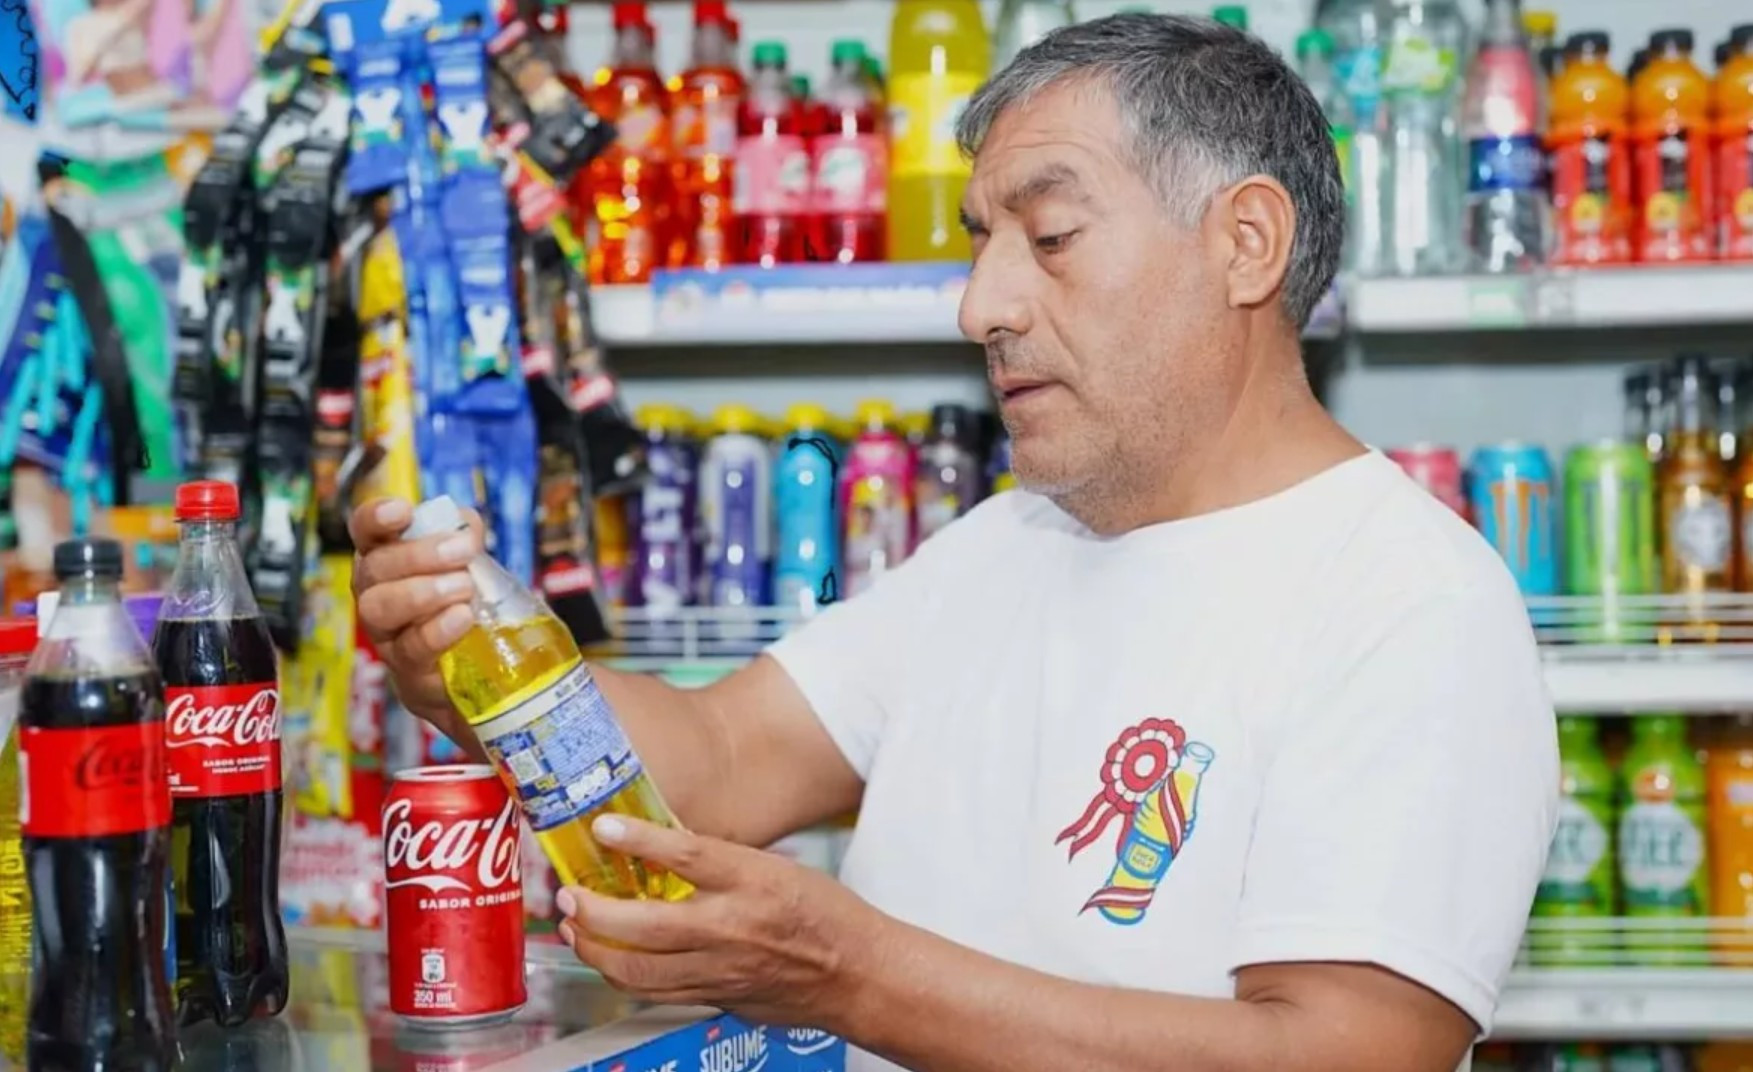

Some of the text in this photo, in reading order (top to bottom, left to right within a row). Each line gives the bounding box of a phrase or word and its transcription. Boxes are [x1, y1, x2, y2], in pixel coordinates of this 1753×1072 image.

[165, 689, 281, 748] Coca-Col
[419, 898, 471, 909] SABOR
[414, 989, 452, 1003] 350 ml
[700, 1026, 767, 1072] SUBLIME
